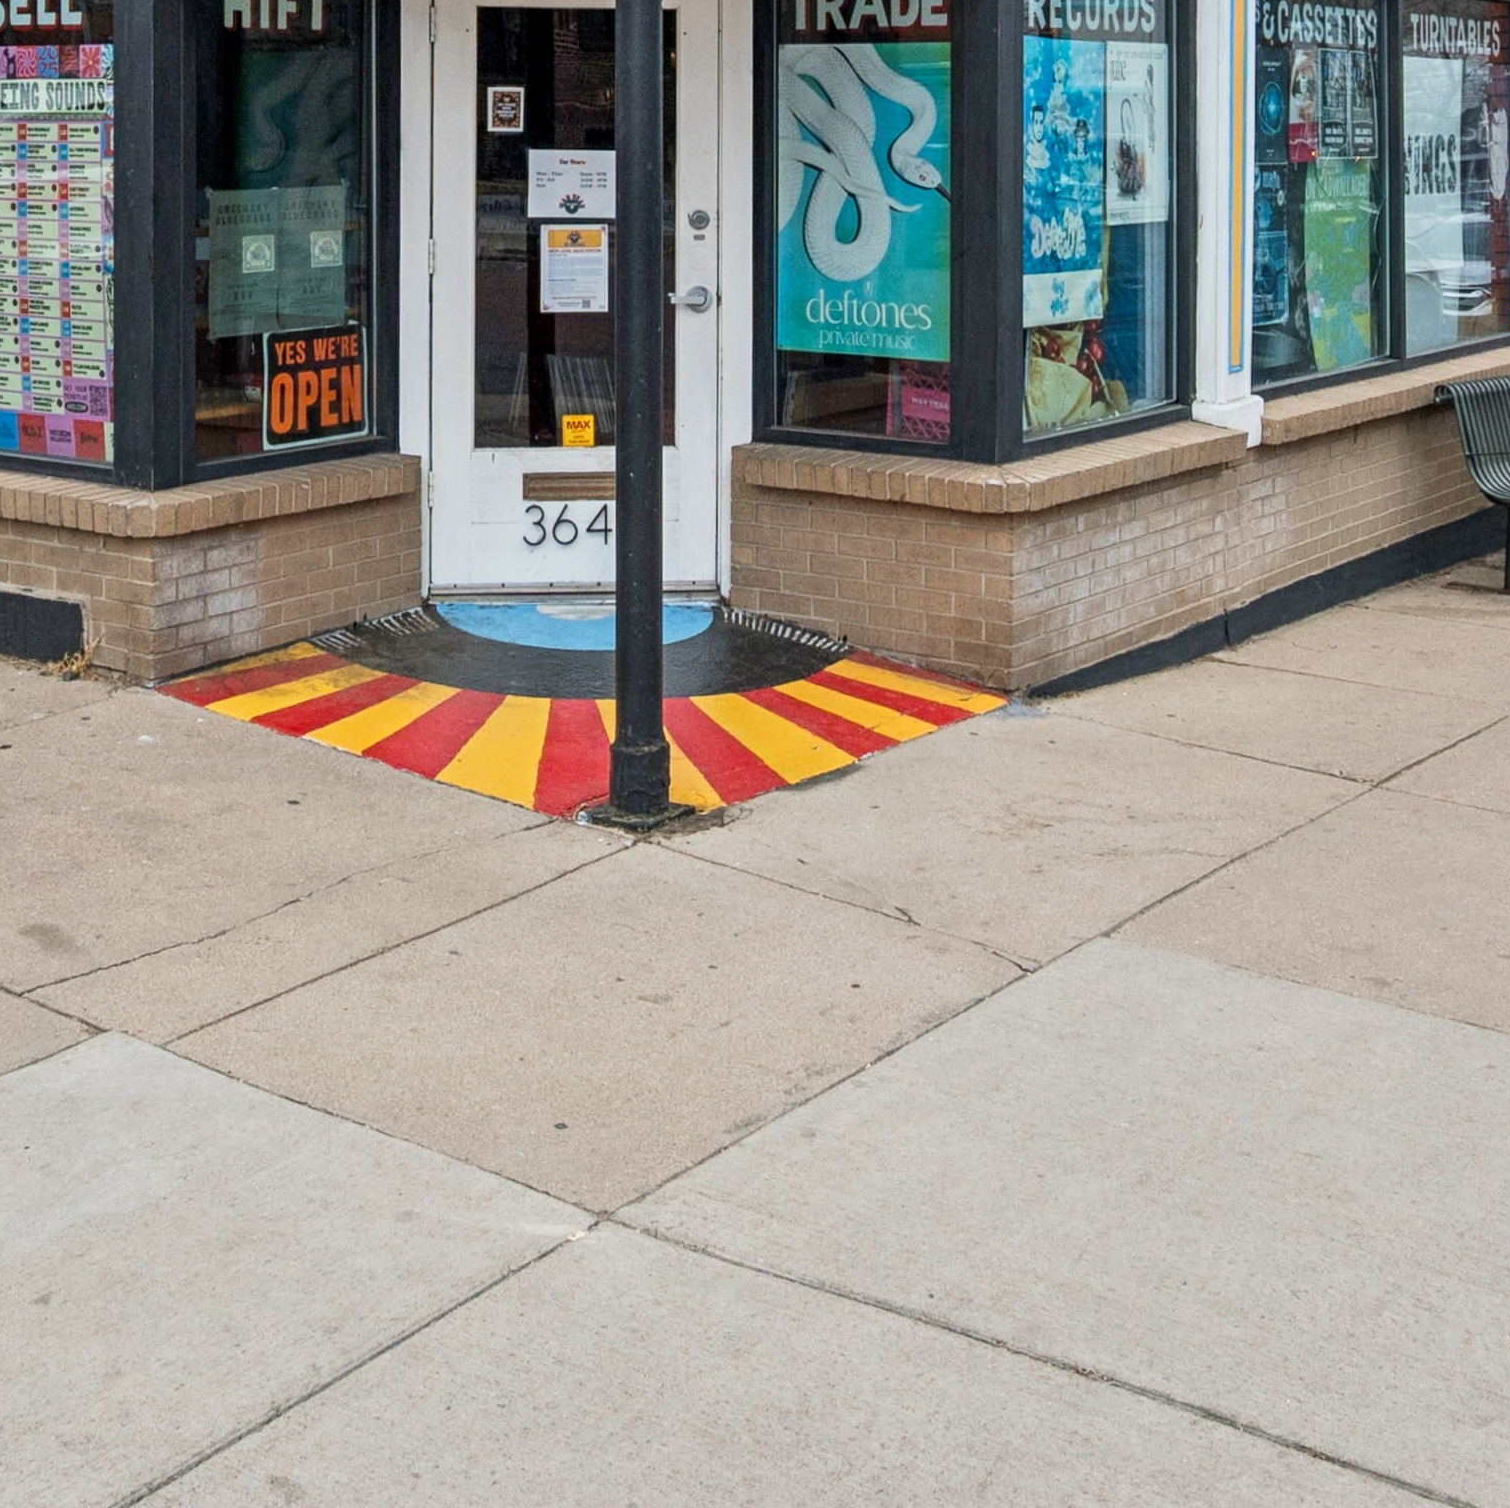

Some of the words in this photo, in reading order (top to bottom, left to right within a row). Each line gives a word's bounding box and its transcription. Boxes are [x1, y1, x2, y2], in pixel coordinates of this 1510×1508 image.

[1278, 2, 1378, 50] CASSETTES
[1409, 12, 1501, 57] TURNTABLES
[46, 81, 105, 111] SOUNDS
[806, 289, 932, 331] deftones
[274, 338, 306, 367] YES
[313, 332, 359, 359] WE'RE
[819, 326, 870, 349] private
[872, 331, 917, 350] music
[270, 363, 363, 435] OPEN
[566, 420, 591, 430] MAX
